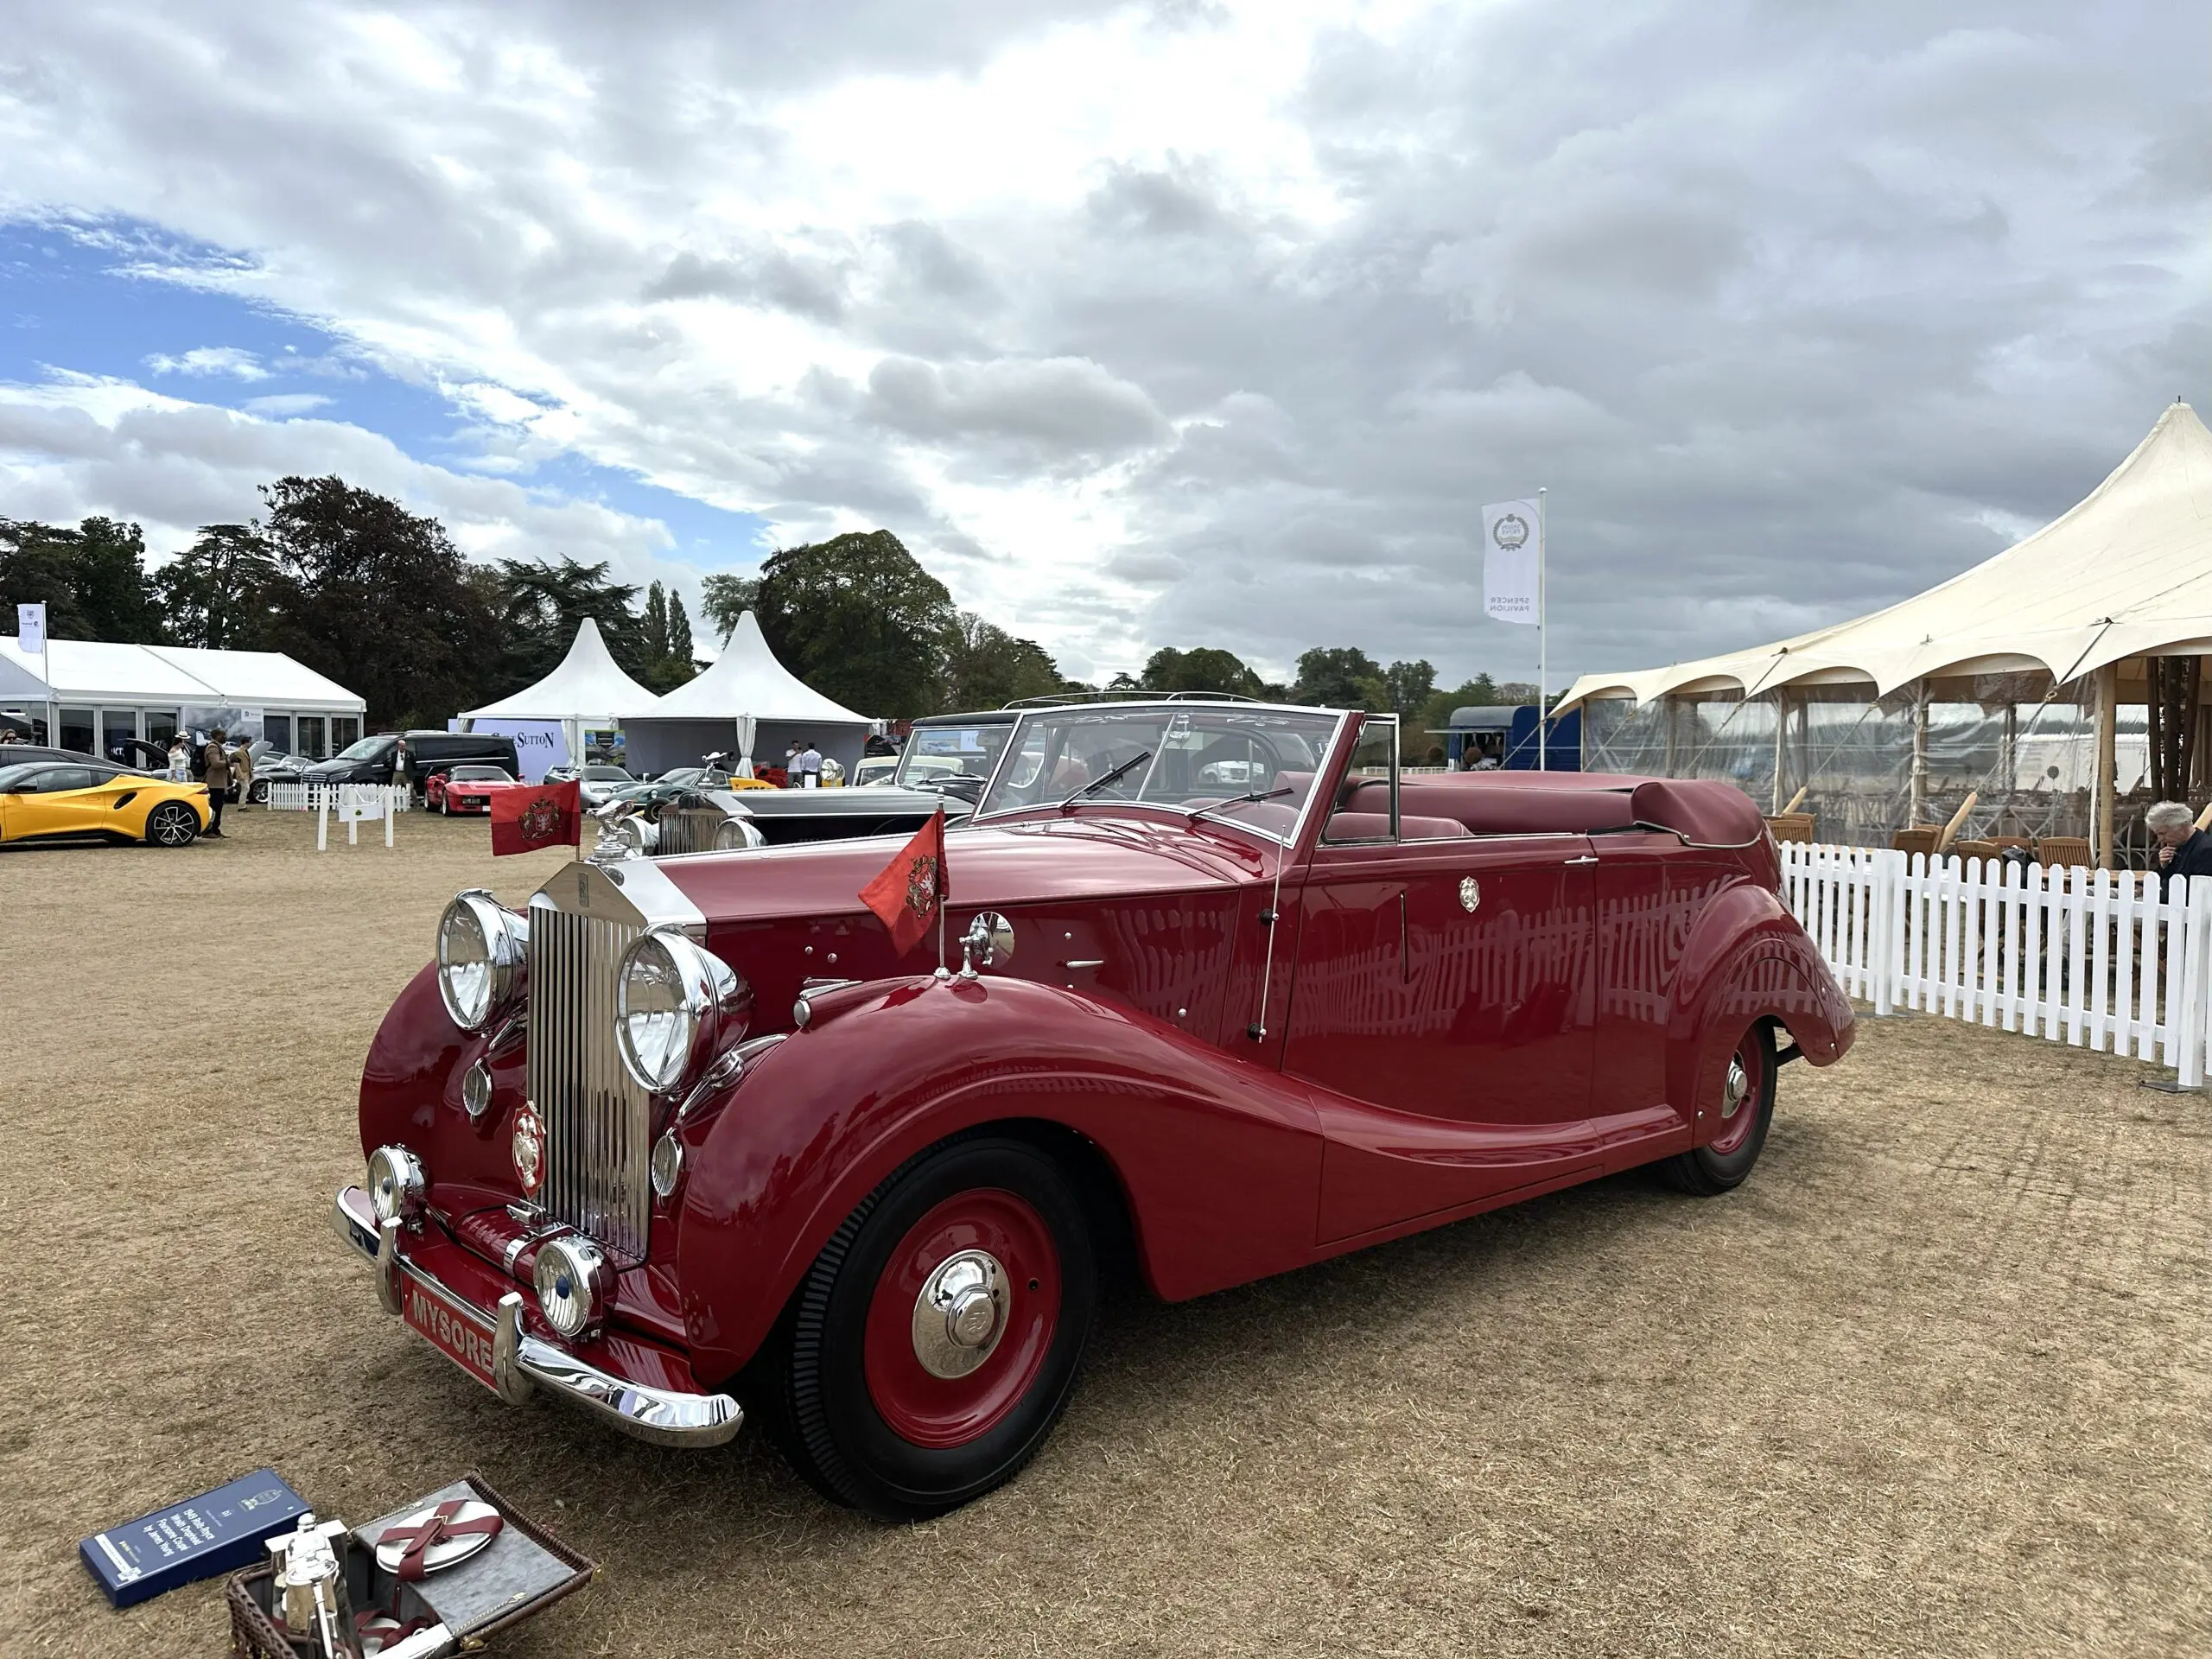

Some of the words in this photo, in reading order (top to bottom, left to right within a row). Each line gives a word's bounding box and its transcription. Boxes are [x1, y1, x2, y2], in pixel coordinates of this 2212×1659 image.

[412, 1290, 494, 1375] MYSORE
[156, 1518, 177, 1539] Foursome
[170, 1514, 186, 1528] Wraith
[181, 1526, 204, 1545] Drophead
[183, 1509, 198, 1519] 1949
[191, 1517, 214, 1540] Rolls-Royce
[148, 1531, 163, 1544] James
[160, 1541, 174, 1556] Young
